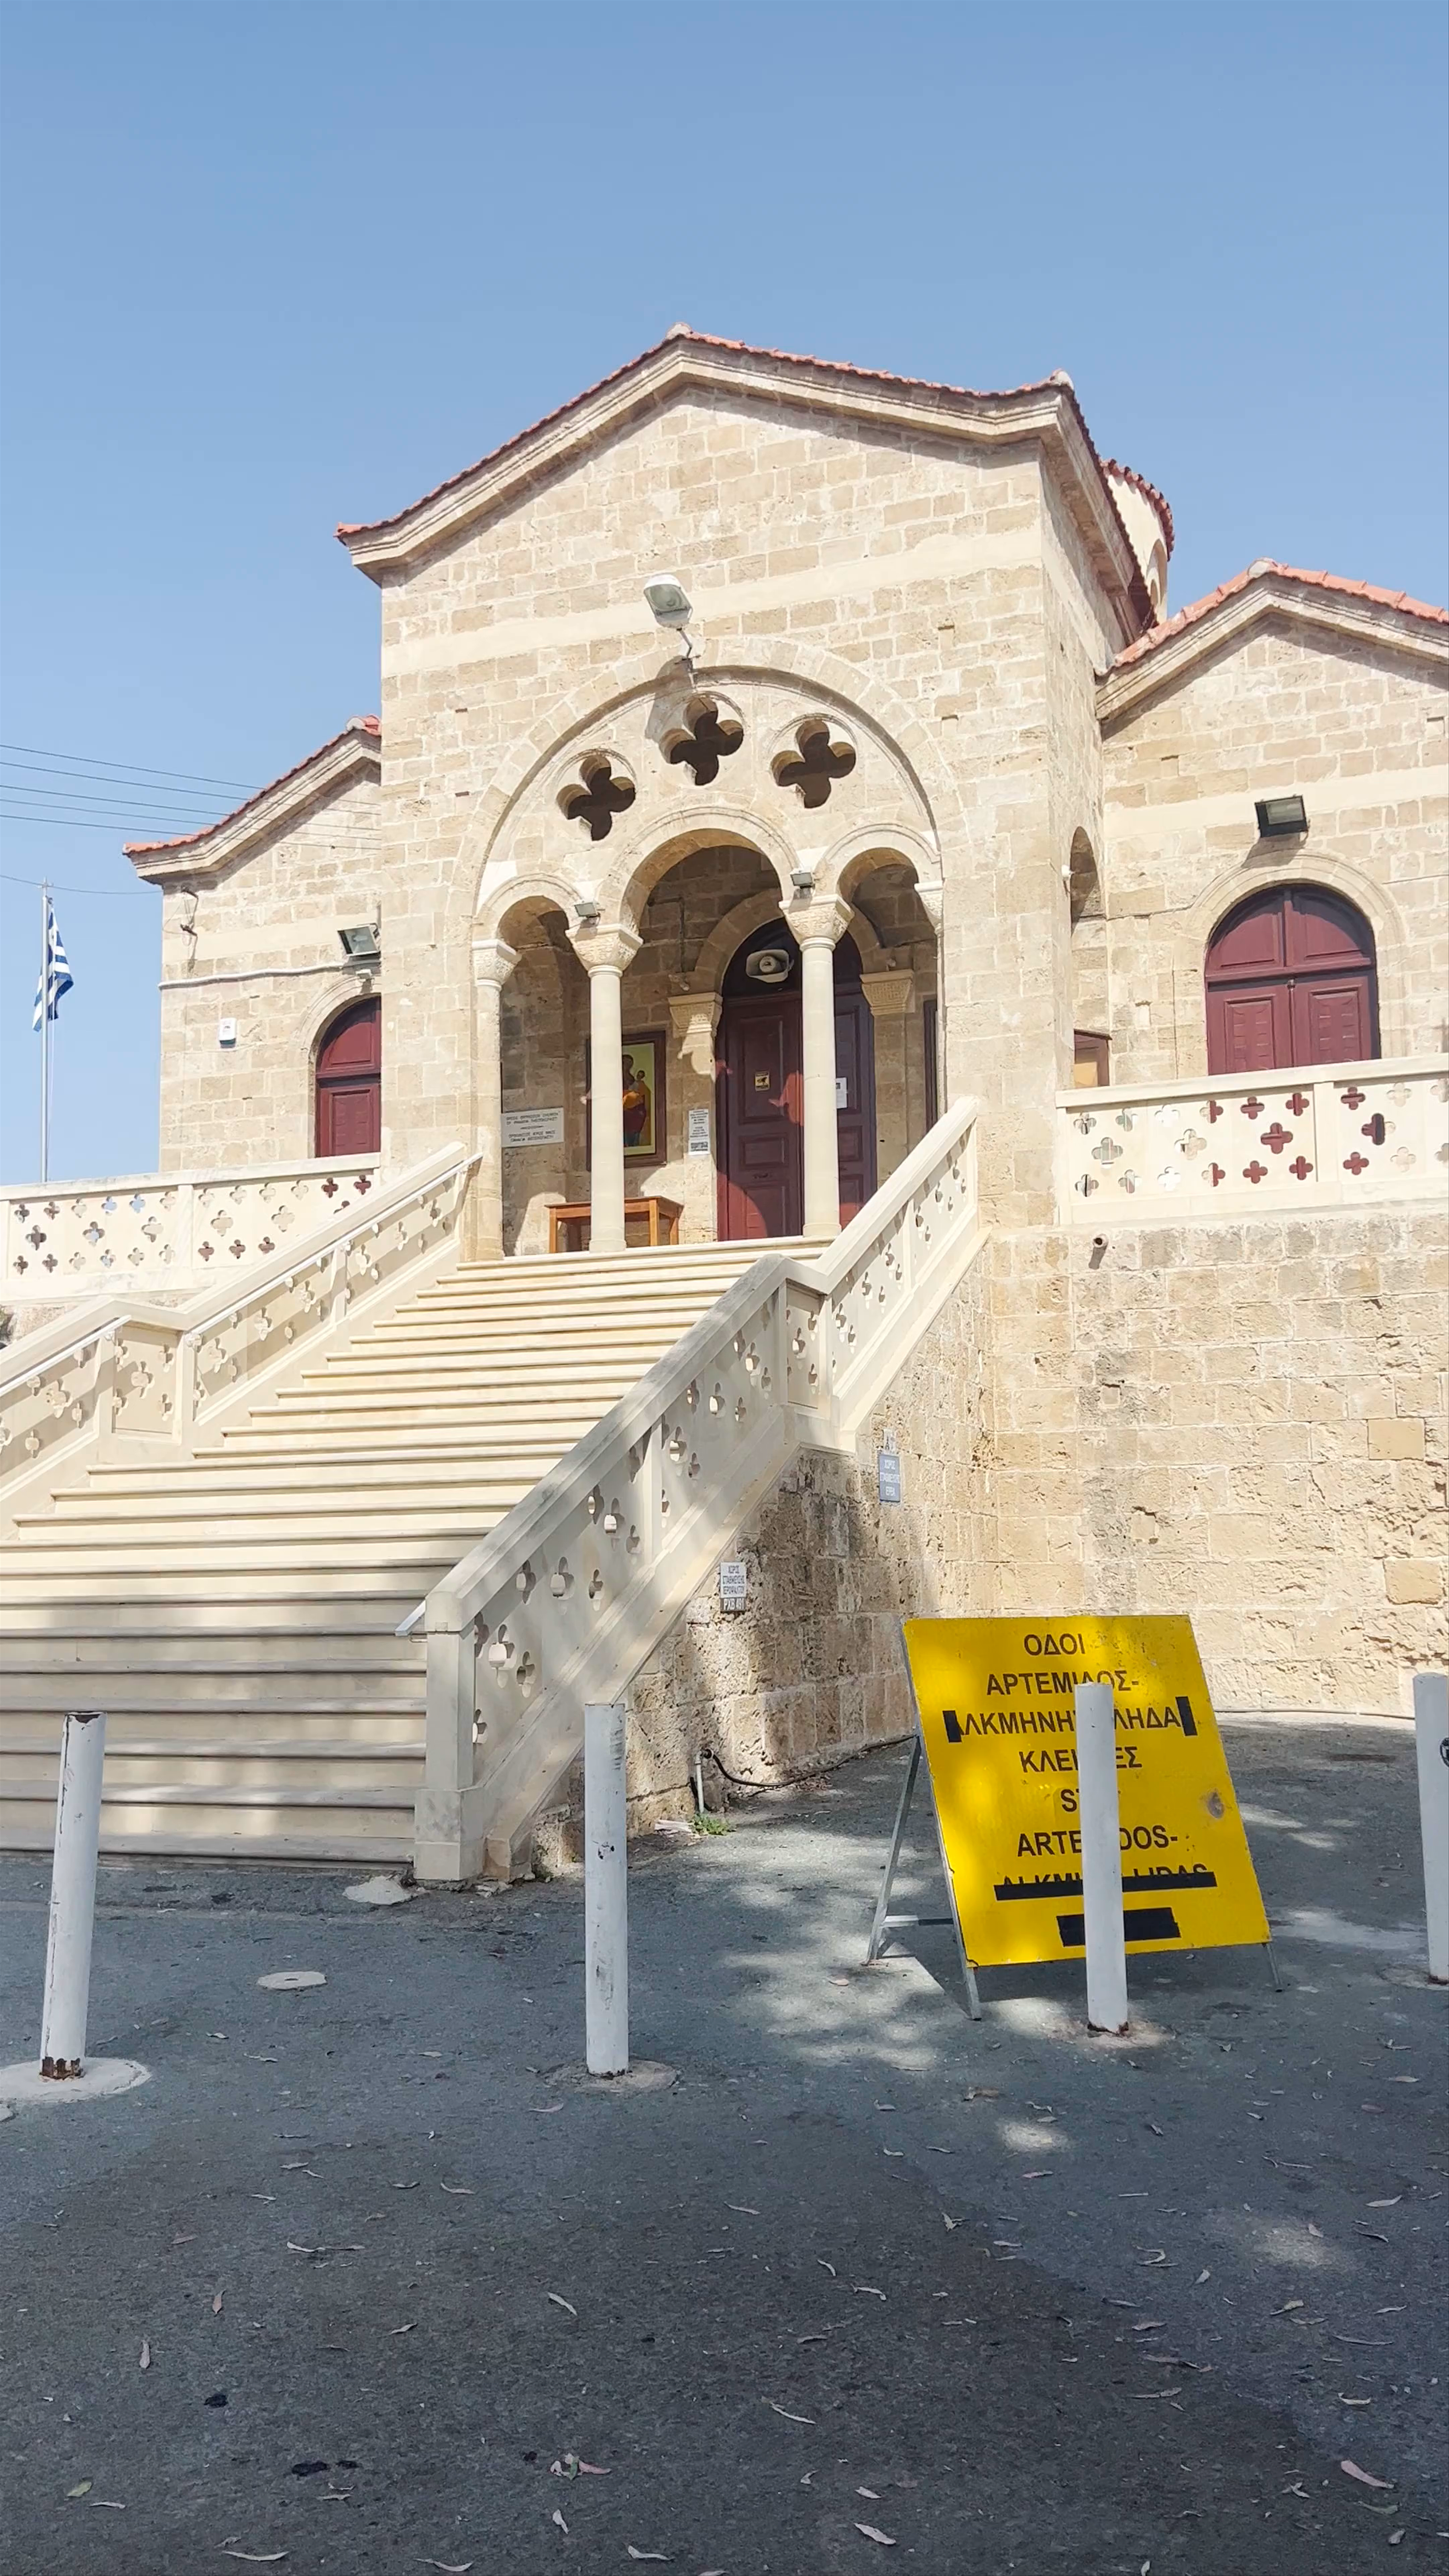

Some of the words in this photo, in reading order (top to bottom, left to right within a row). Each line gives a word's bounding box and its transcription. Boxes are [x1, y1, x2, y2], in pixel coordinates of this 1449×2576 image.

[1024, 1633, 1085, 1656] ΟΔΟΙ
[1018, 1746, 1142, 1773] ΚΛΕΙΕΣ
[1017, 1825, 1178, 1857] ARTEDOS-
